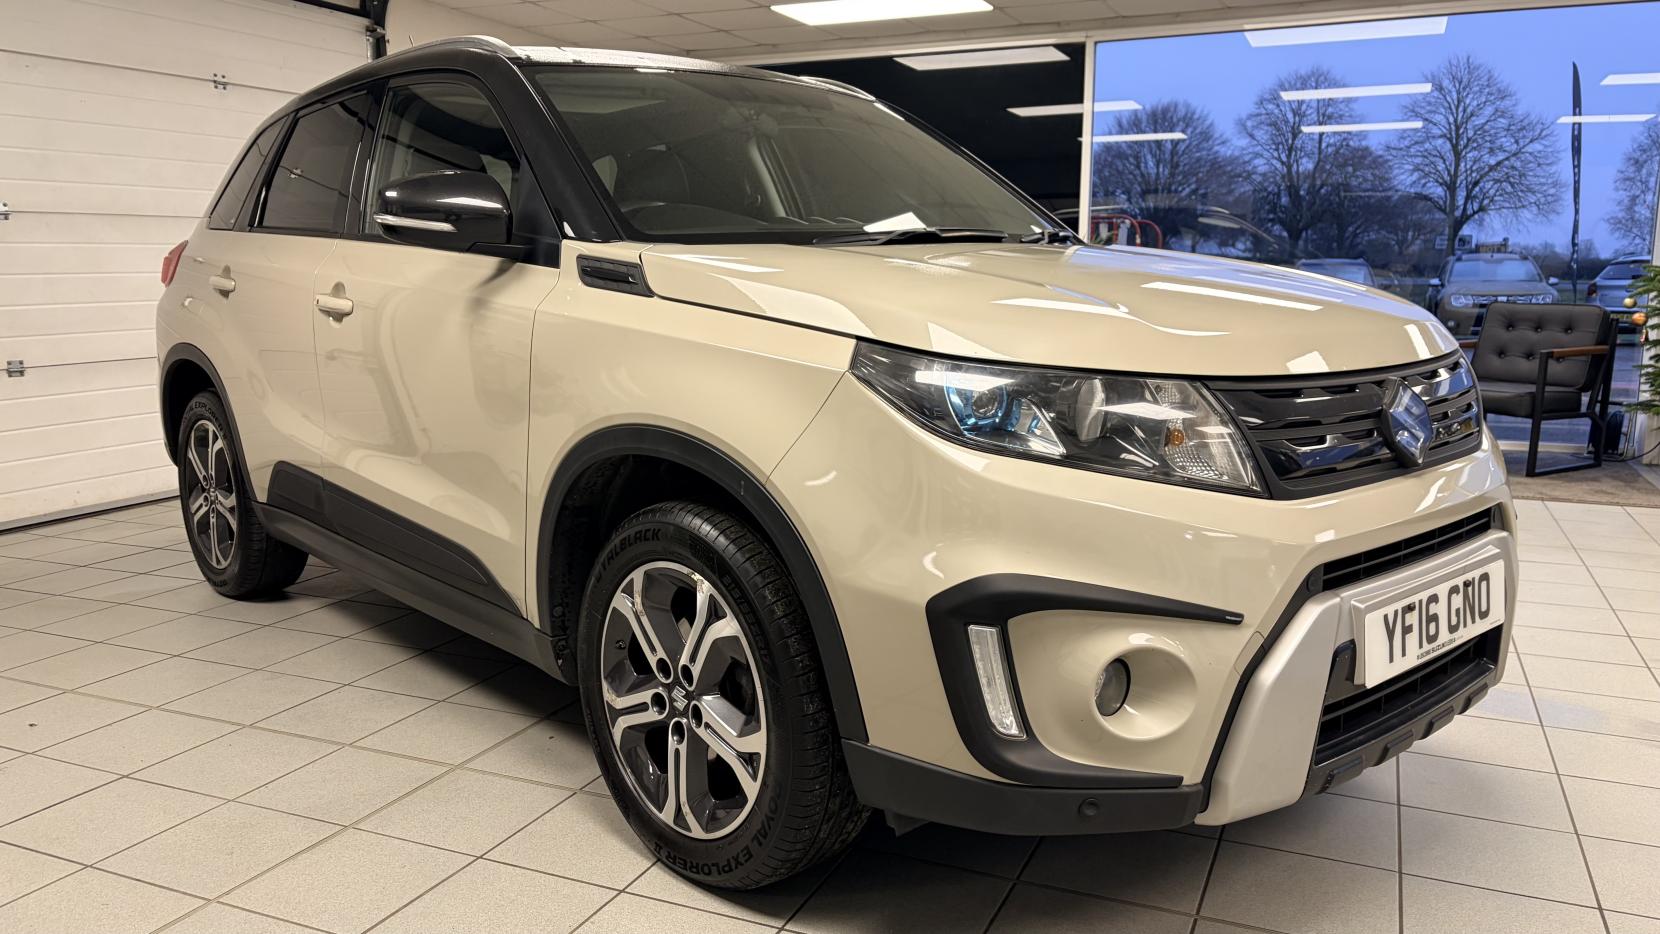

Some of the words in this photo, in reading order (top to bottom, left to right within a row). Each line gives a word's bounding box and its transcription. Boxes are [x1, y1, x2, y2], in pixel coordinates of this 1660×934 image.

[1384, 593, 1440, 664] YF16
[1447, 572, 1490, 634] GNO
[752, 781, 786, 847] ROYAL
[665, 846, 754, 877] EXPLORER
